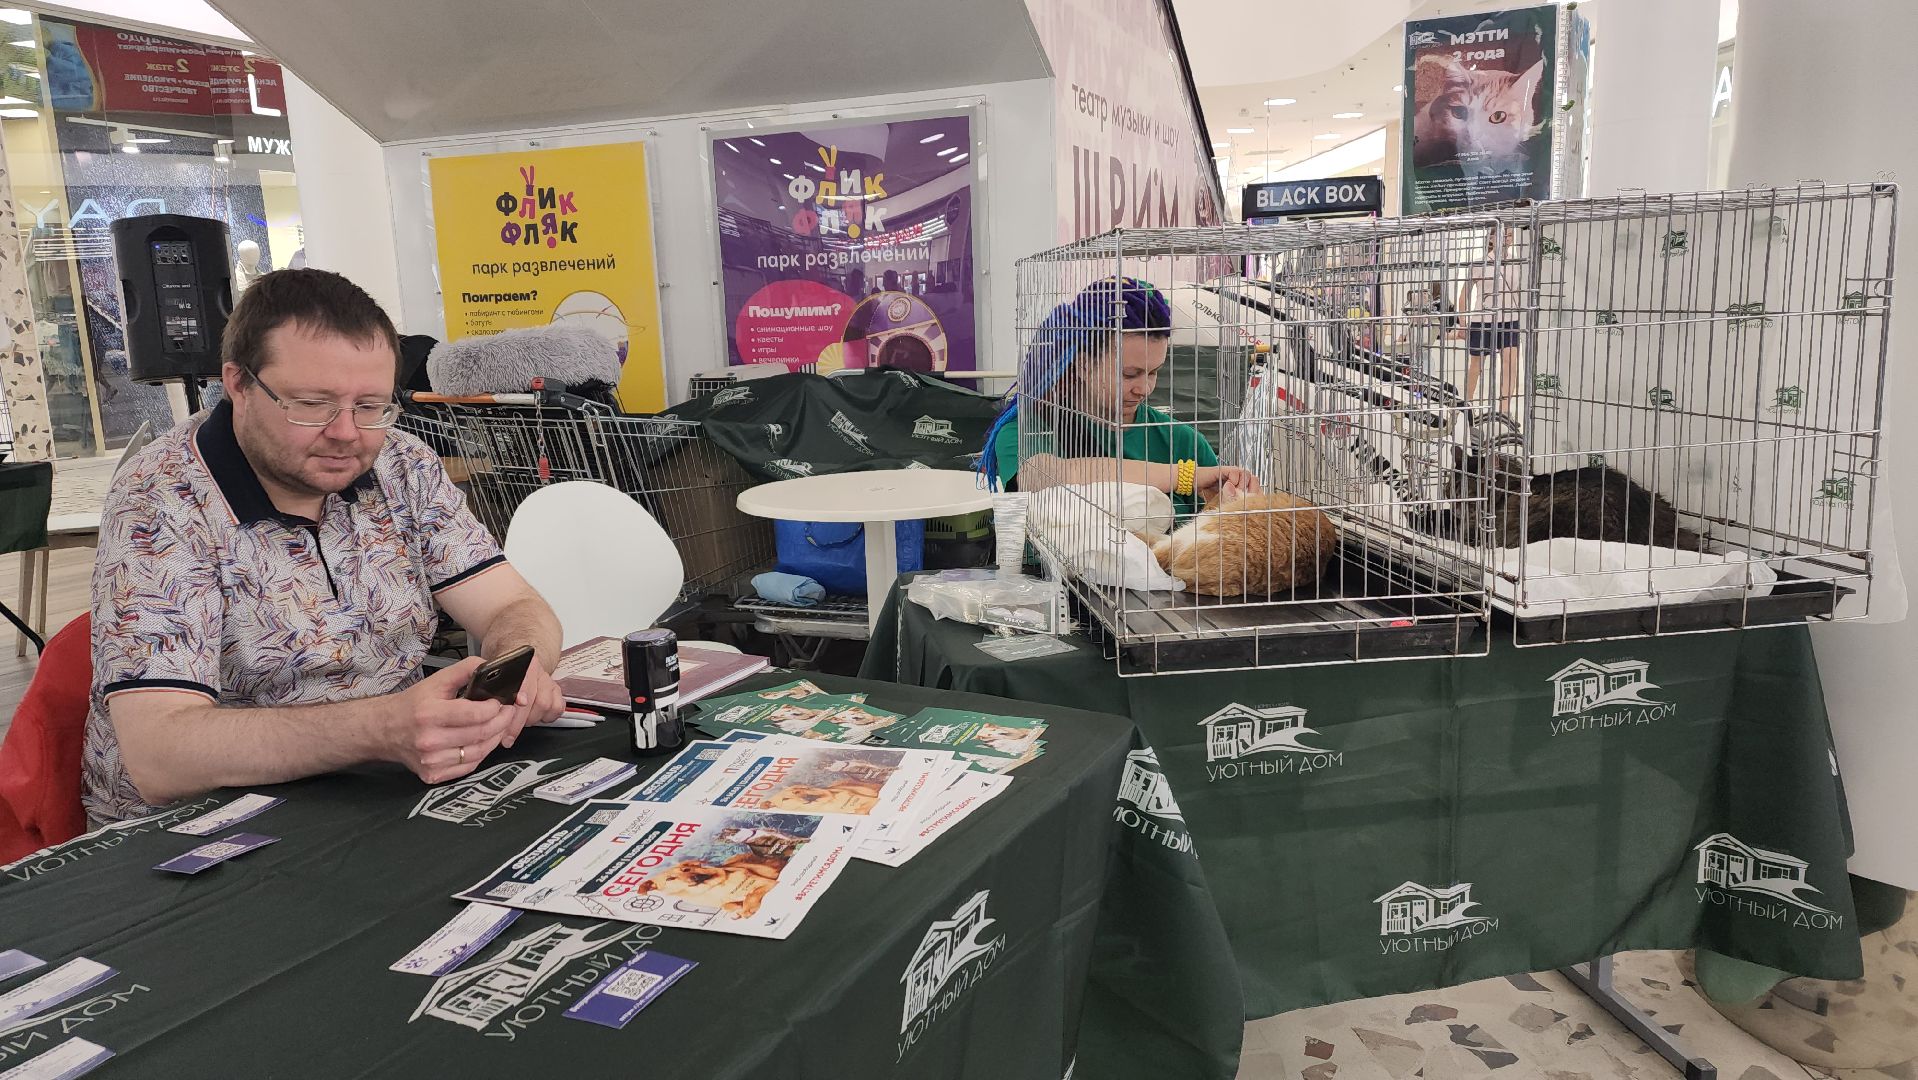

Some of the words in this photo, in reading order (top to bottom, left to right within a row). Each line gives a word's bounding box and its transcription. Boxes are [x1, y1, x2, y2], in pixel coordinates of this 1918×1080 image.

[1451, 28, 1509, 46] МЭТТИ
[1453, 50, 1462, 62] 2
[1467, 48, 1505, 61] года
[1071, 83, 1108, 132] театр
[1111, 109, 1151, 139] музыки
[1154, 120, 1160, 135] и
[1162, 129, 1180, 158] шоу
[496, 185, 578, 219] ФЛИК
[1256, 186, 1320, 208] BLACK
[1325, 184, 1367, 204] BOX
[472, 261, 509, 278] парк
[513, 253, 616, 277] развлечений
[757, 253, 801, 272] парк
[805, 242, 930, 270] развлечений
[462, 290, 538, 304] Поиграем?
[748, 303, 842, 320] Пошумим?
[1550, 707, 1632, 737] УЮТНЫЙ
[1635, 702, 1677, 726] ДОМ
[733, 757, 800, 809] ЕГОДНЯ
[1206, 754, 1294, 783] УЮТНЫЙ
[1299, 751, 1344, 777] ДОМ
[157, 797, 219, 829] ДОМ
[602, 821, 703, 898] СЕГОДНЯ
[1694, 887, 1788, 924] УЮТНЫЙ
[1793, 912, 1844, 931] ДОМ
[1379, 931, 1459, 955] УЮТНЫЙ
[1460, 918, 1499, 941] ДОМ
[484, 953, 616, 1042] УЮТНЫЙ
[621, 925, 663, 955] ДО
[896, 968, 968, 1064] УЮТНЫЙ
[970, 933, 1006, 988] ДОМ
[61, 983, 151, 1035] ДОМ
